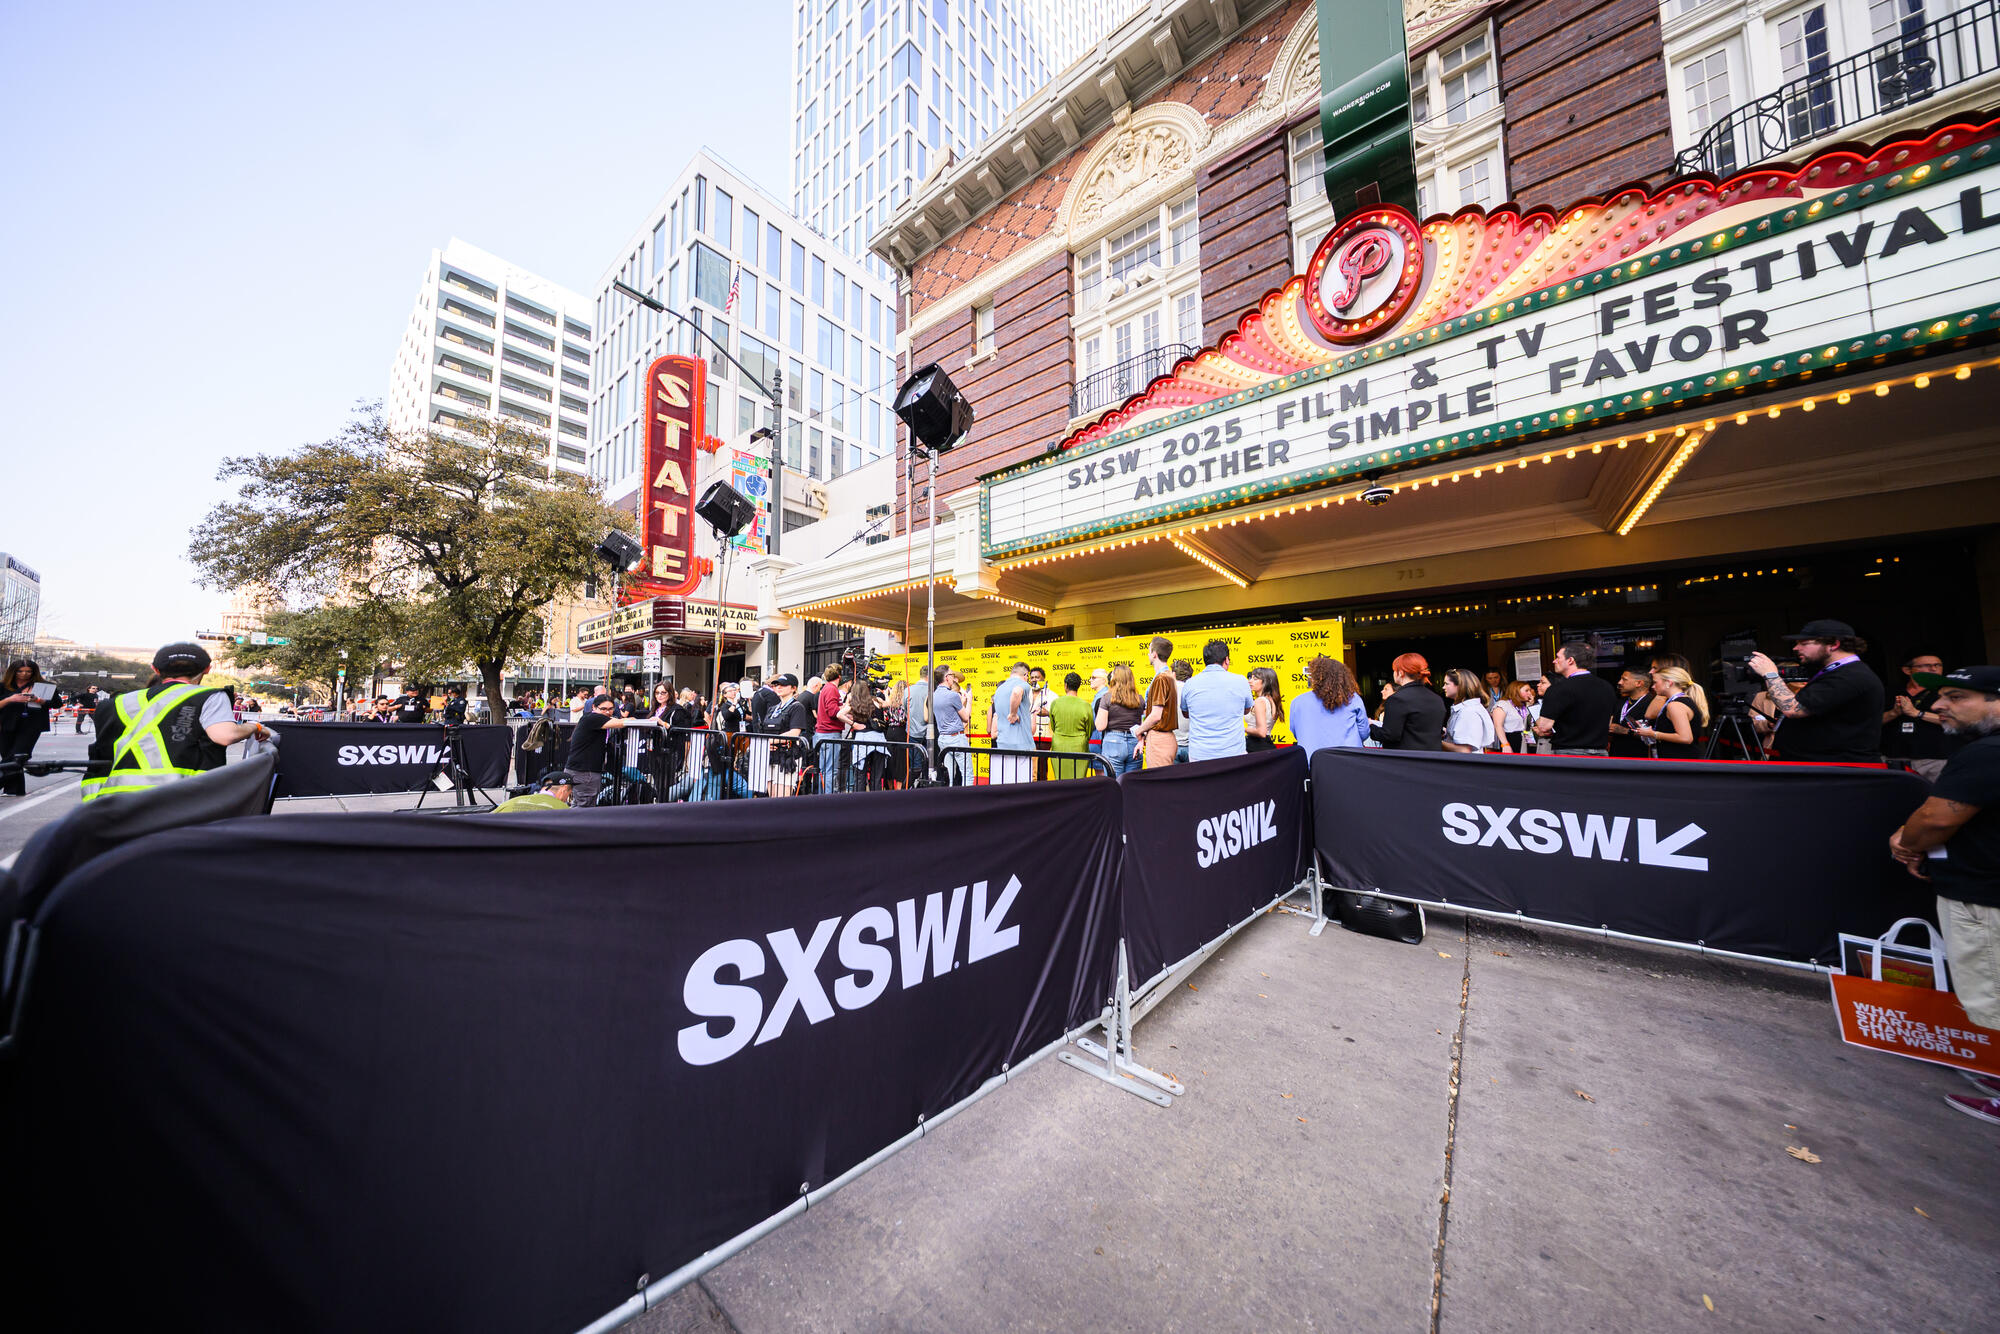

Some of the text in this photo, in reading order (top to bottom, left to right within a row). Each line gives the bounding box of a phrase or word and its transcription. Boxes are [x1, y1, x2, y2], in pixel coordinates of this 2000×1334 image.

[1332, 80, 1391, 118] WAGNERSIGN.COM
[1068, 186, 2000, 490] SXSW 2025 FILM & TV FESTIVAL
[1133, 309, 1771, 501] ANOTHER SIMPLE FAVOR
[651, 372, 691, 583] STATE
[1396, 567, 1425, 581] 713
[687, 604, 718, 617] HANK
[736, 621, 747, 631] 10
[1290, 631, 1319, 641] SXSW
[1027, 649, 1044, 657] SXSW
[1079, 646, 1098, 654] SXSW
[1248, 654, 1275, 663] SXSW
[1139, 677, 1153, 685] SXS
[338, 744, 427, 766] SXSW
[1196, 803, 1260, 869] SXSW
[1441, 802, 1631, 862] SXSW
[677, 884, 969, 1067] SXSW
[1853, 1001, 1908, 1021] WHAT
[1855, 1010, 1992, 1046] STARTS HERE
[1857, 1019, 1952, 1046] CHANGES
[1858, 1026, 1977, 1060] THE WORLD
